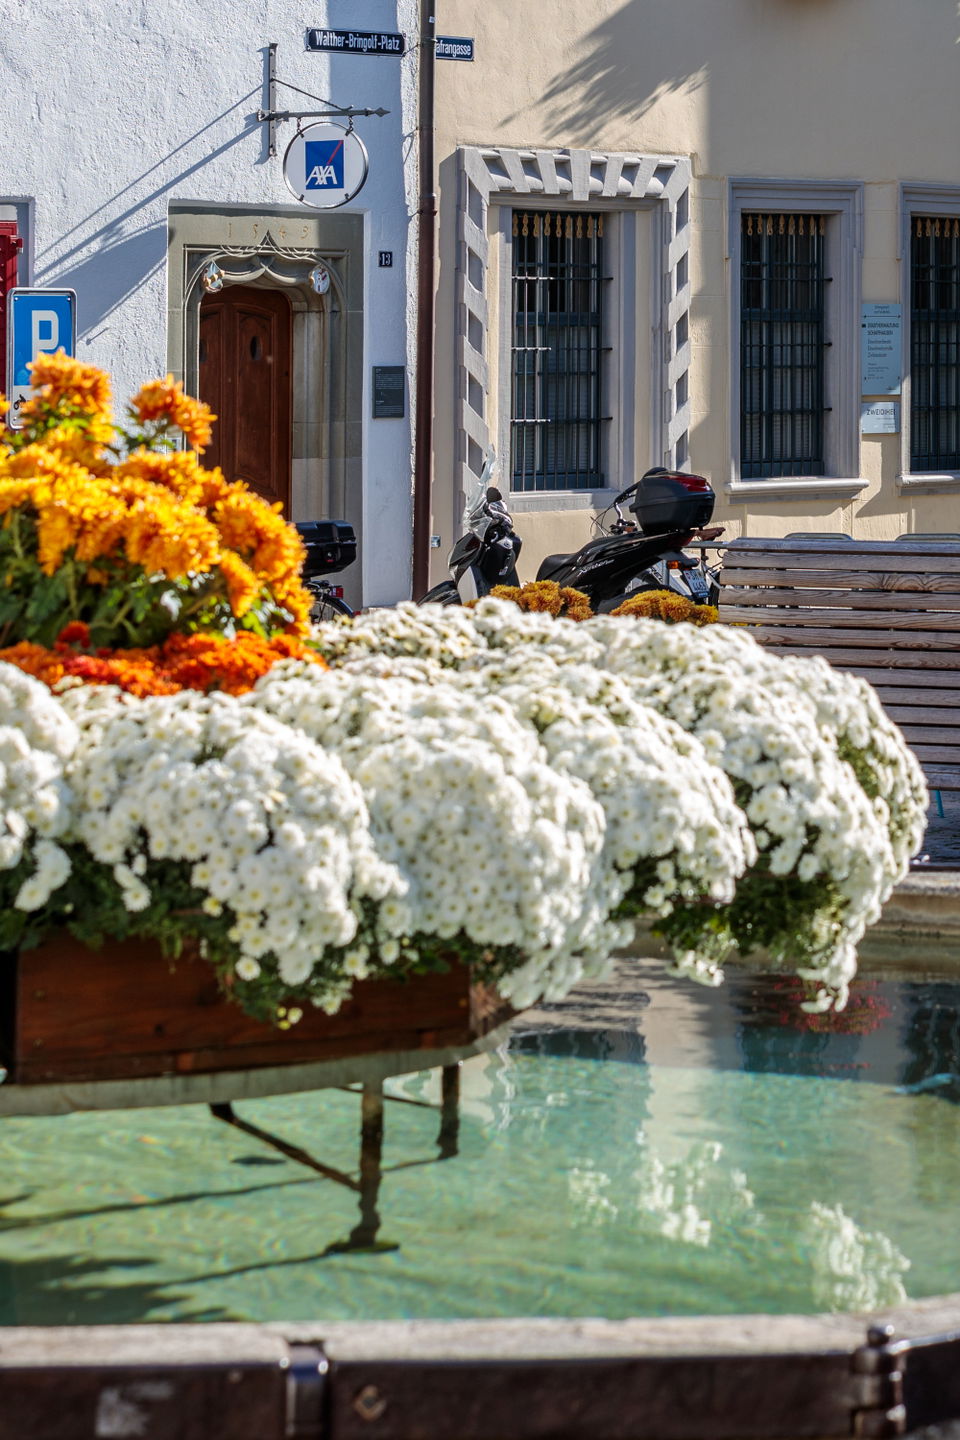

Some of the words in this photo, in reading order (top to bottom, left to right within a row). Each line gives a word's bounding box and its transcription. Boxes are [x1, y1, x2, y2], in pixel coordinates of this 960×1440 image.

[315, 31, 400, 52] Walther-Bringolf-Platz
[436, 41, 472, 58] afrangasse
[306, 165, 338, 186] AXA
[381, 252, 391, 266] 13
[32, 310, 59, 375] P
